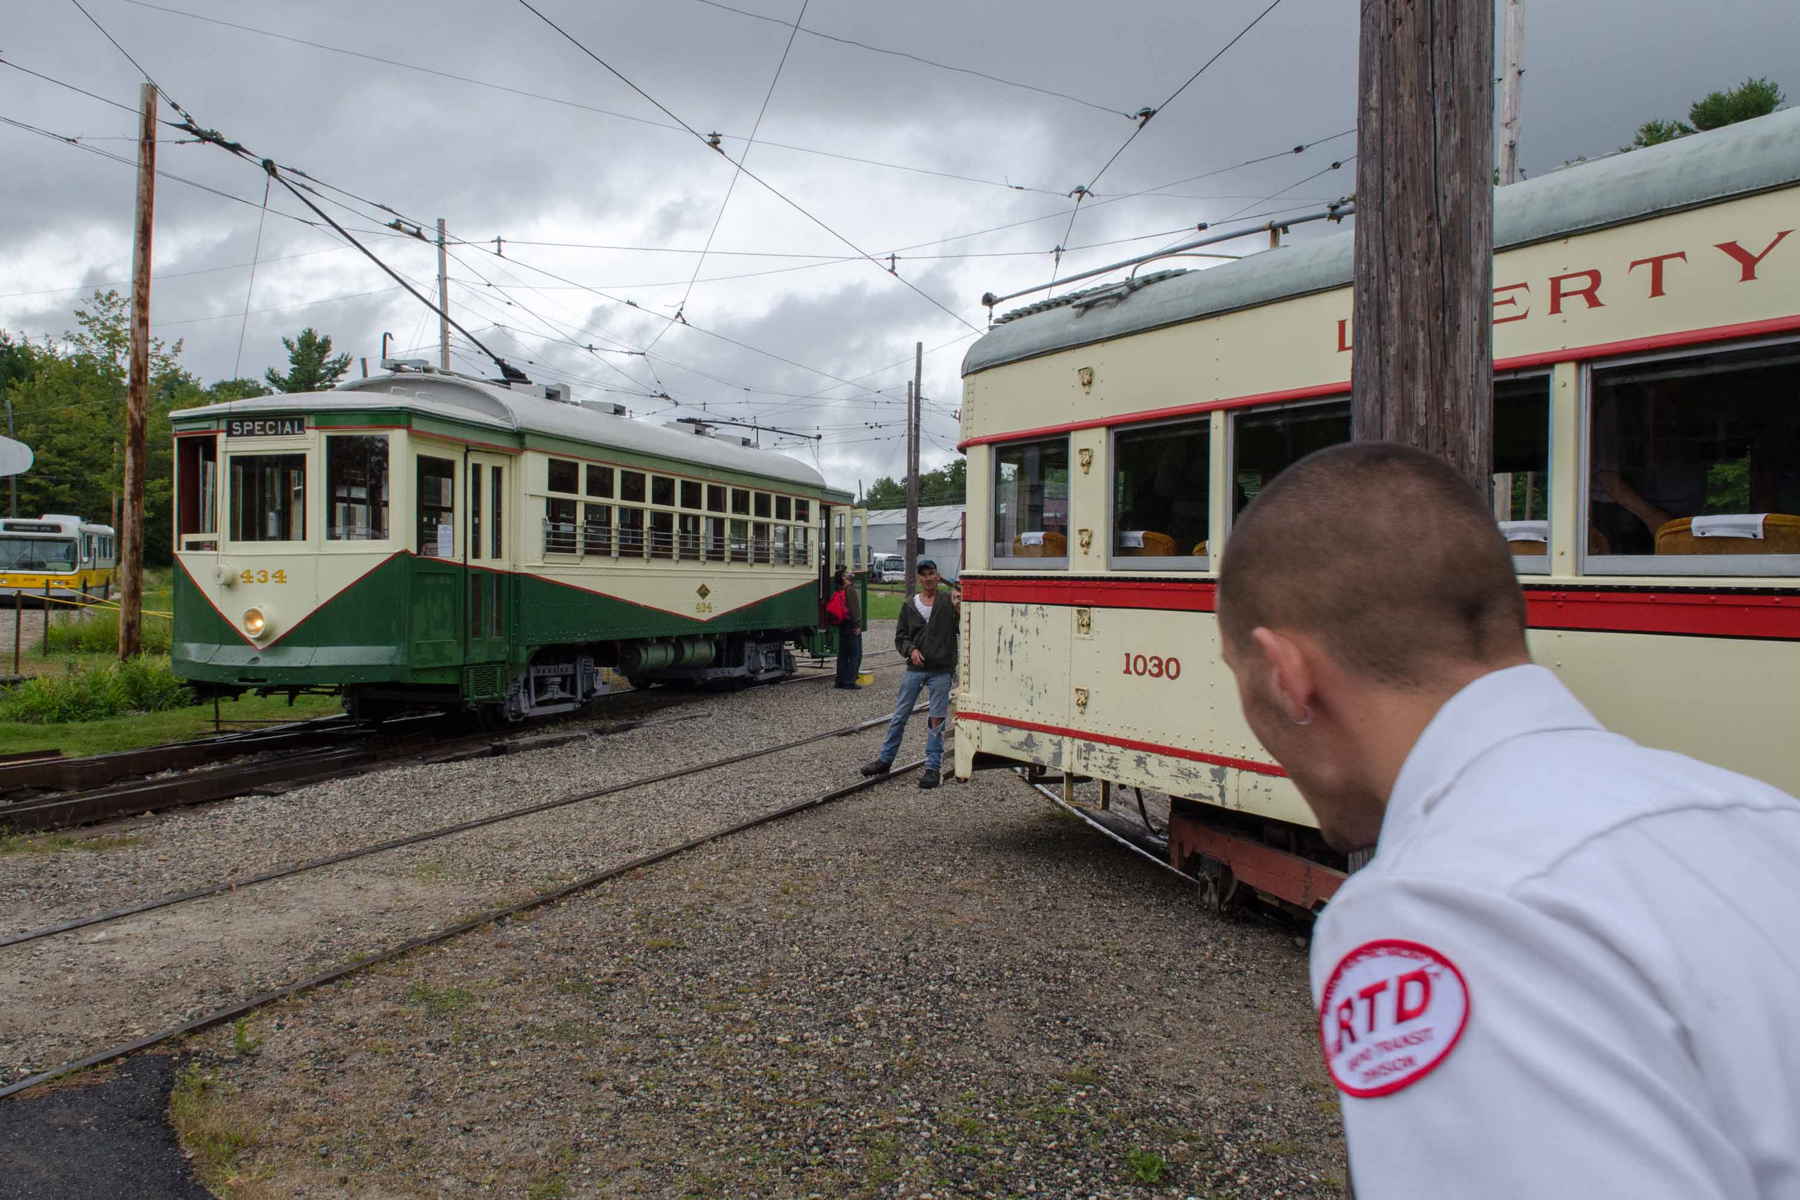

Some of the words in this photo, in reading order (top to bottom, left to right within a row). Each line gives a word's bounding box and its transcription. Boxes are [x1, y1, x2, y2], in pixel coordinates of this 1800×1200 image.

[1336, 229, 1796, 352] LERTY
[232, 420, 304, 435] SPECIAL
[240, 569, 287, 584] 434
[1123, 652, 1180, 680] 1030
[1335, 969, 1432, 1053] RTD
